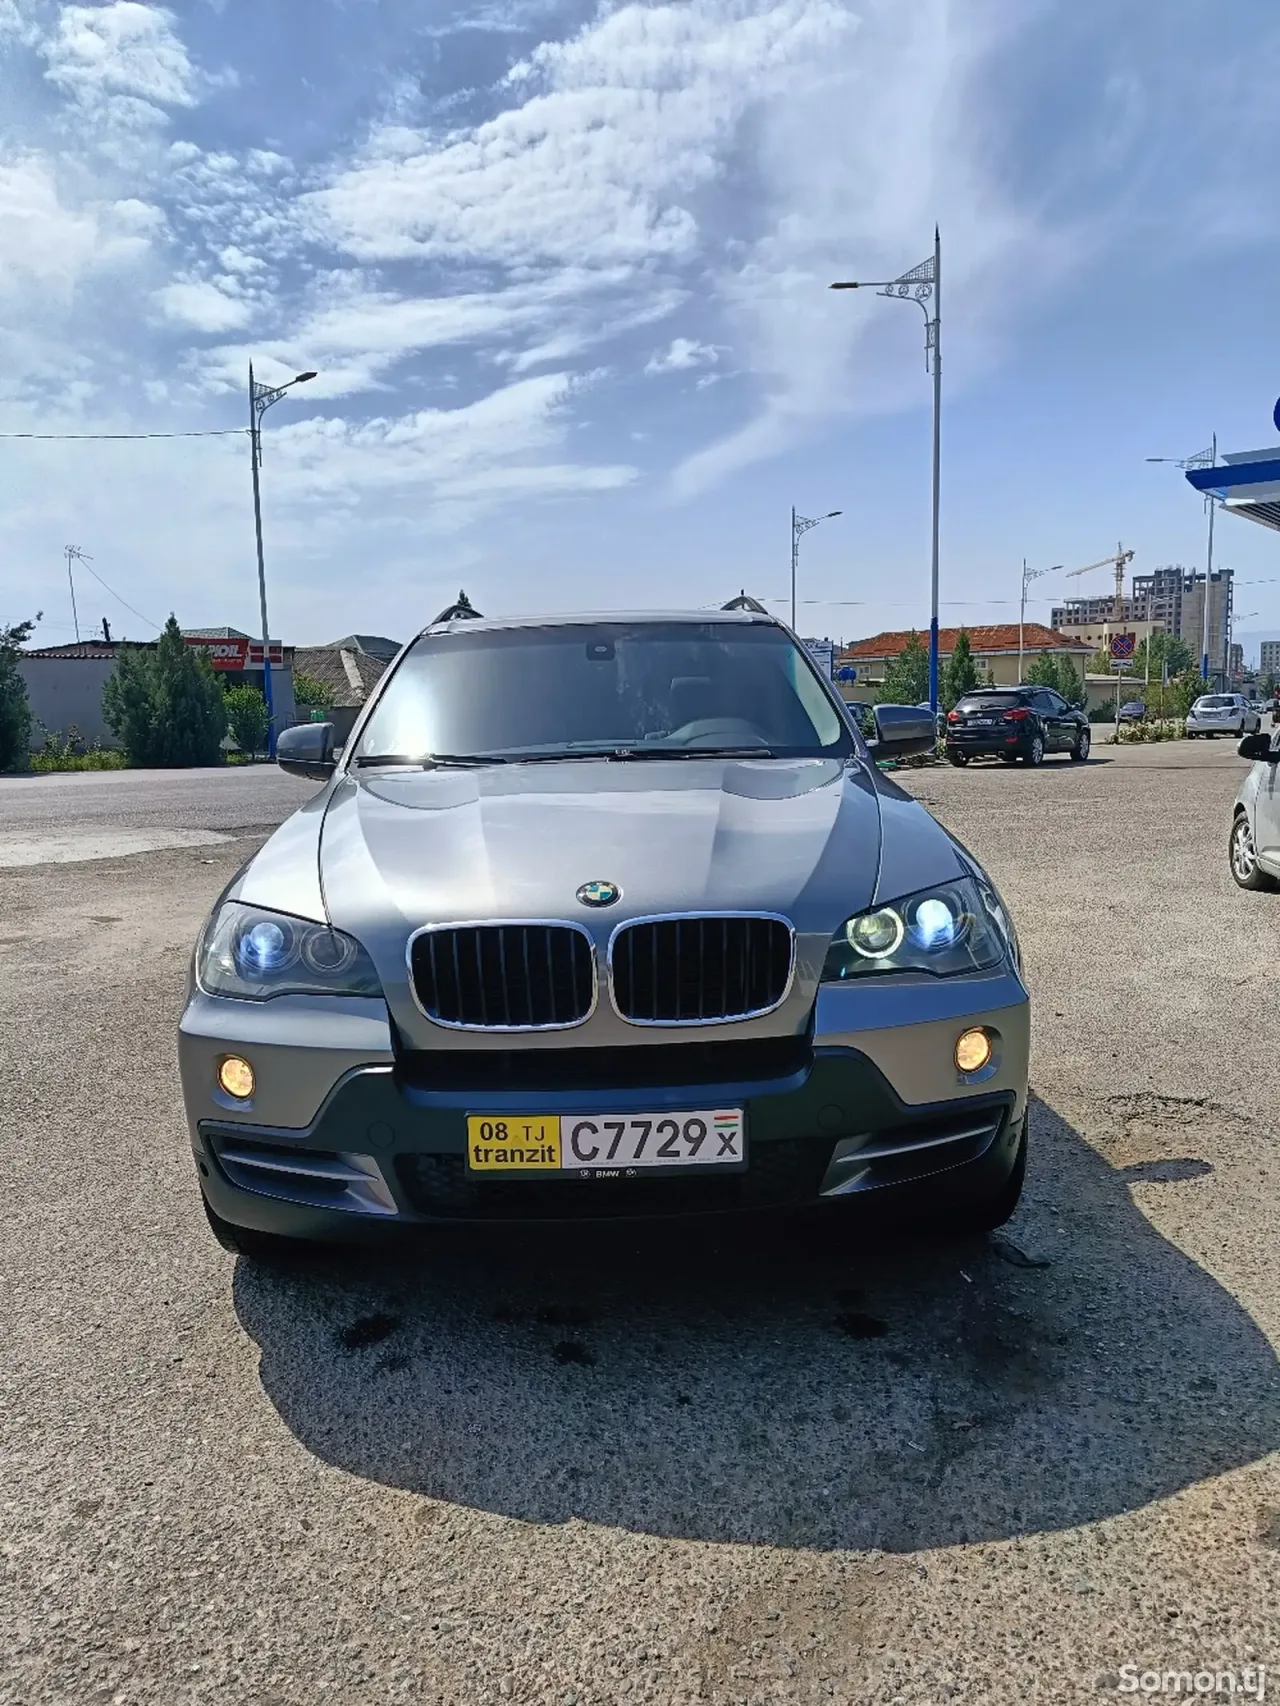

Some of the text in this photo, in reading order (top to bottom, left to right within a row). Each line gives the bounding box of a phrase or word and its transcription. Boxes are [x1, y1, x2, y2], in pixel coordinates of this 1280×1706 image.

[480, 1122, 545, 1141] 08 TJ
[571, 1118, 707, 1161] C7729
[473, 1143, 555, 1164] tranzit
[716, 1131, 738, 1156] X
[595, 1170, 620, 1178] BMW
